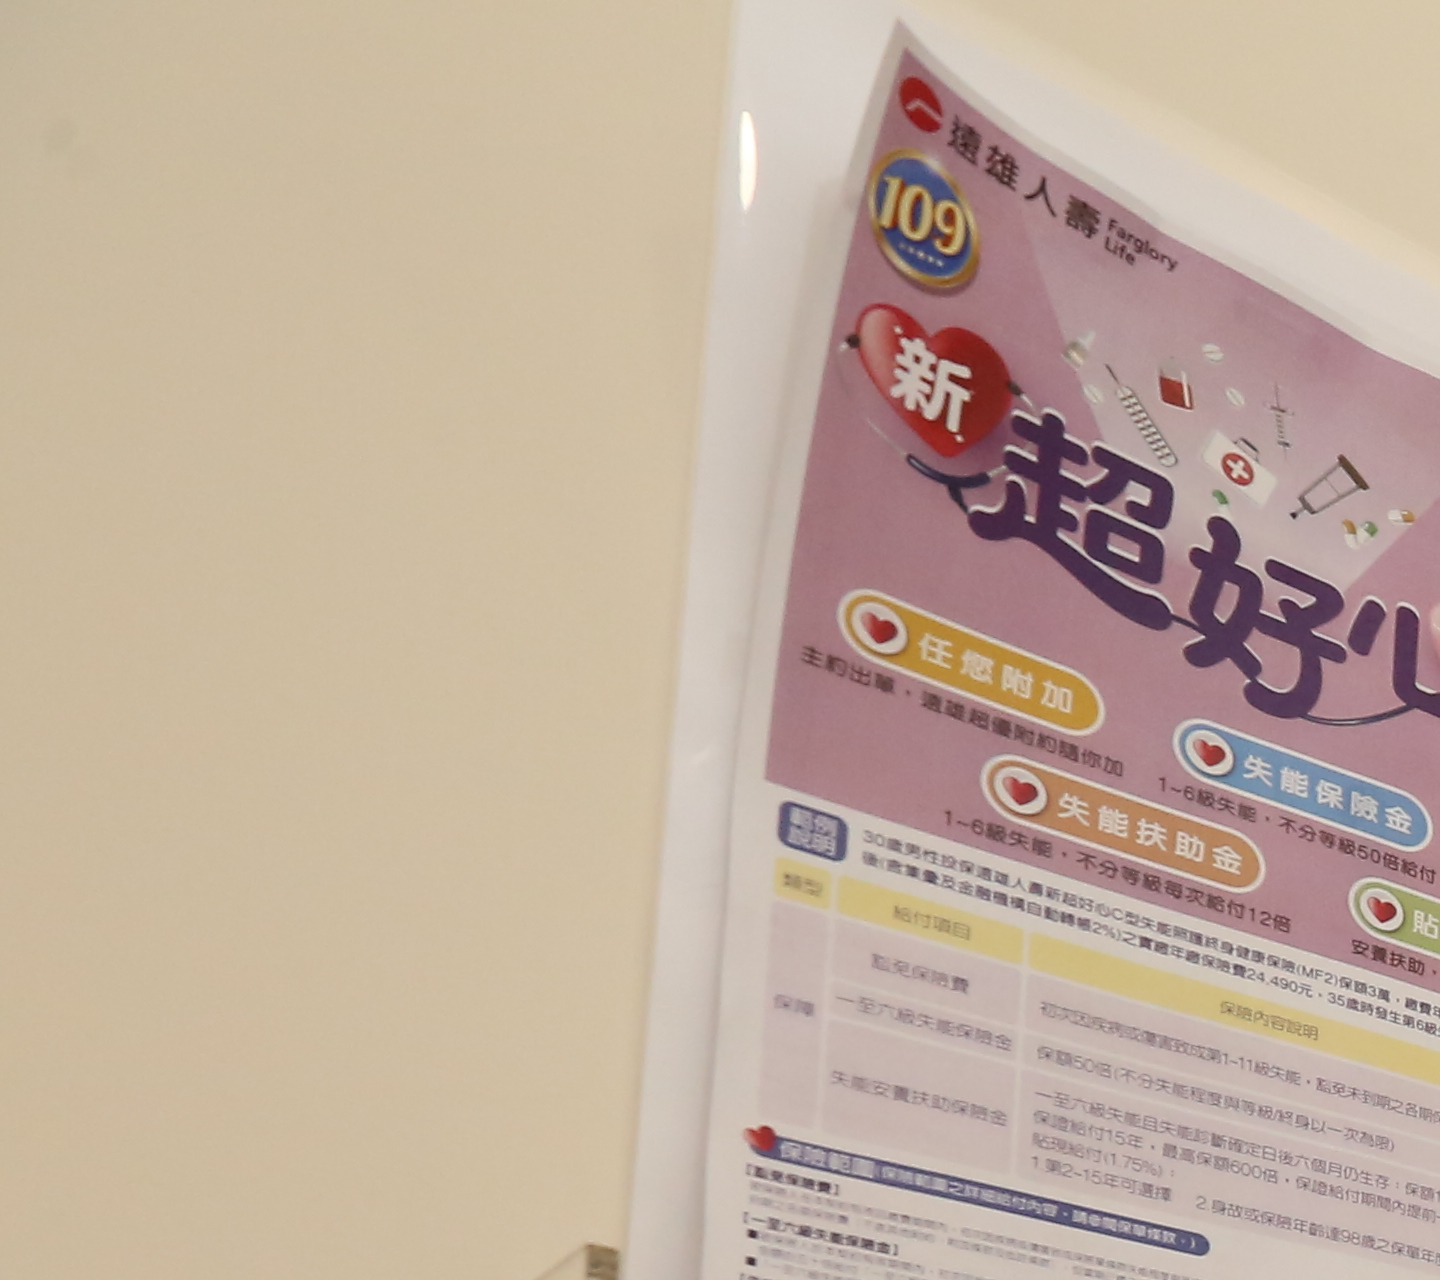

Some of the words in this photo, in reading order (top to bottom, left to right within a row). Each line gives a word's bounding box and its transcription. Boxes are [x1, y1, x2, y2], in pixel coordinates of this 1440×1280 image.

[876, 175, 967, 257] 109
[946, 115, 1103, 240] 遠雄人壽
[1104, 237, 1137, 267] Life
[1106, 217, 1180, 272] Farglory
[889, 326, 974, 444] 新
[917, 631, 1076, 715] 任您附加
[1056, 791, 1244, 876] 失能扶助金
[1157, 775, 1438, 886] 1~6級失能，不分等級50倍給付
[1242, 754, 1415, 837] 失能保險金
[942, 808, 1292, 936] 1~6級失能，不分等級每次給付12倍
[892, 904, 973, 942] 給付項目
[870, 952, 971, 995] 豁免保險費
[834, 994, 1014, 1053] 一至六級失能保險金
[1219, 999, 1320, 1042] 保險內容說明
[830, 1069, 1009, 1128] 失能安養扶助保險金
